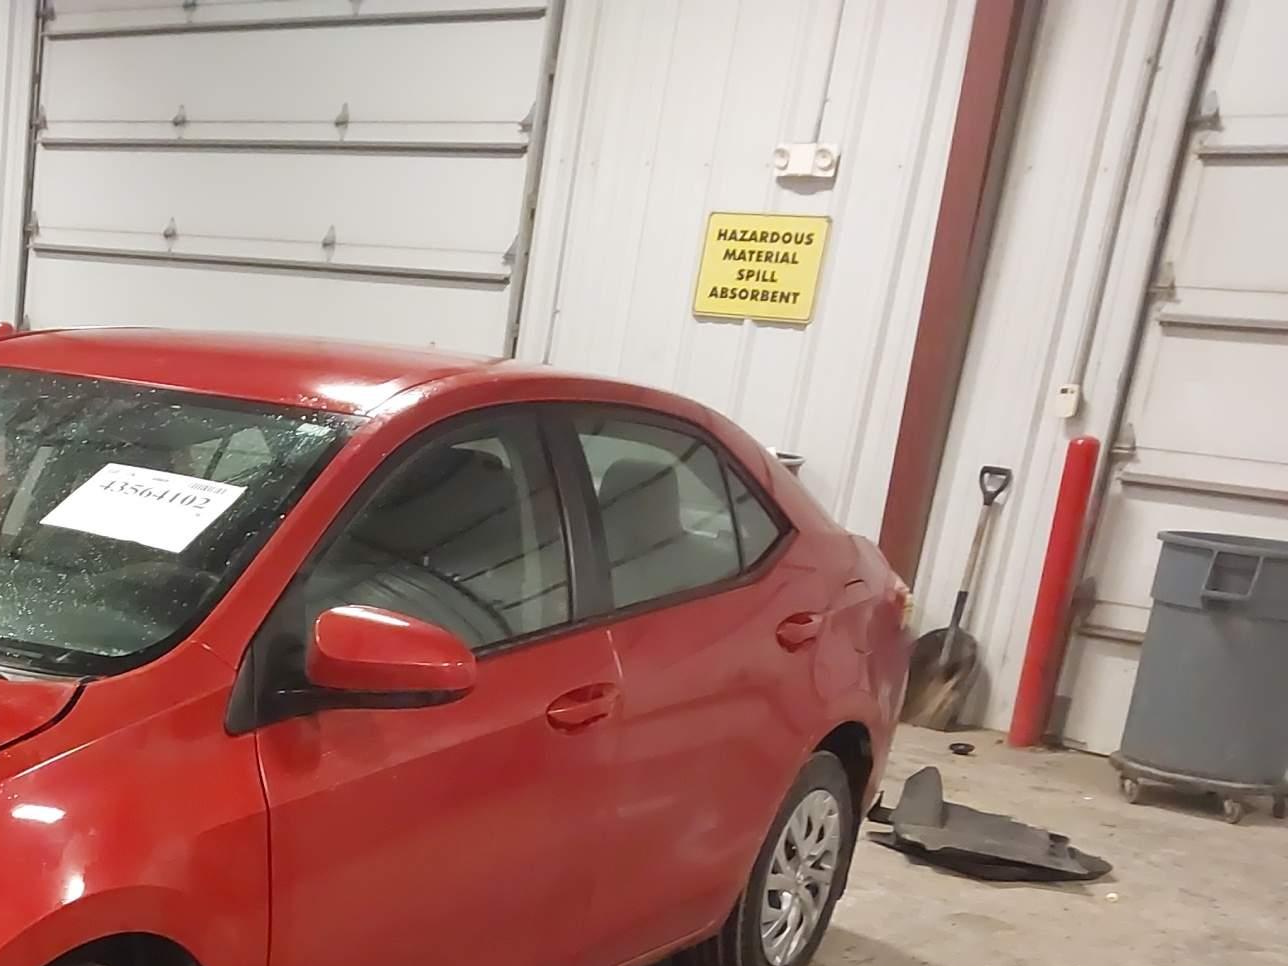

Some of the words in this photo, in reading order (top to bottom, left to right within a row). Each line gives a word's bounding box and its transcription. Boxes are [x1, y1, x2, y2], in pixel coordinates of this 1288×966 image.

[716, 228, 815, 246] HAZARDOUS
[722, 248, 800, 265] MATERIAL
[735, 268, 779, 283] SPILL
[708, 286, 801, 305] ABSORBENT
[99, 479, 212, 510] 43564102
